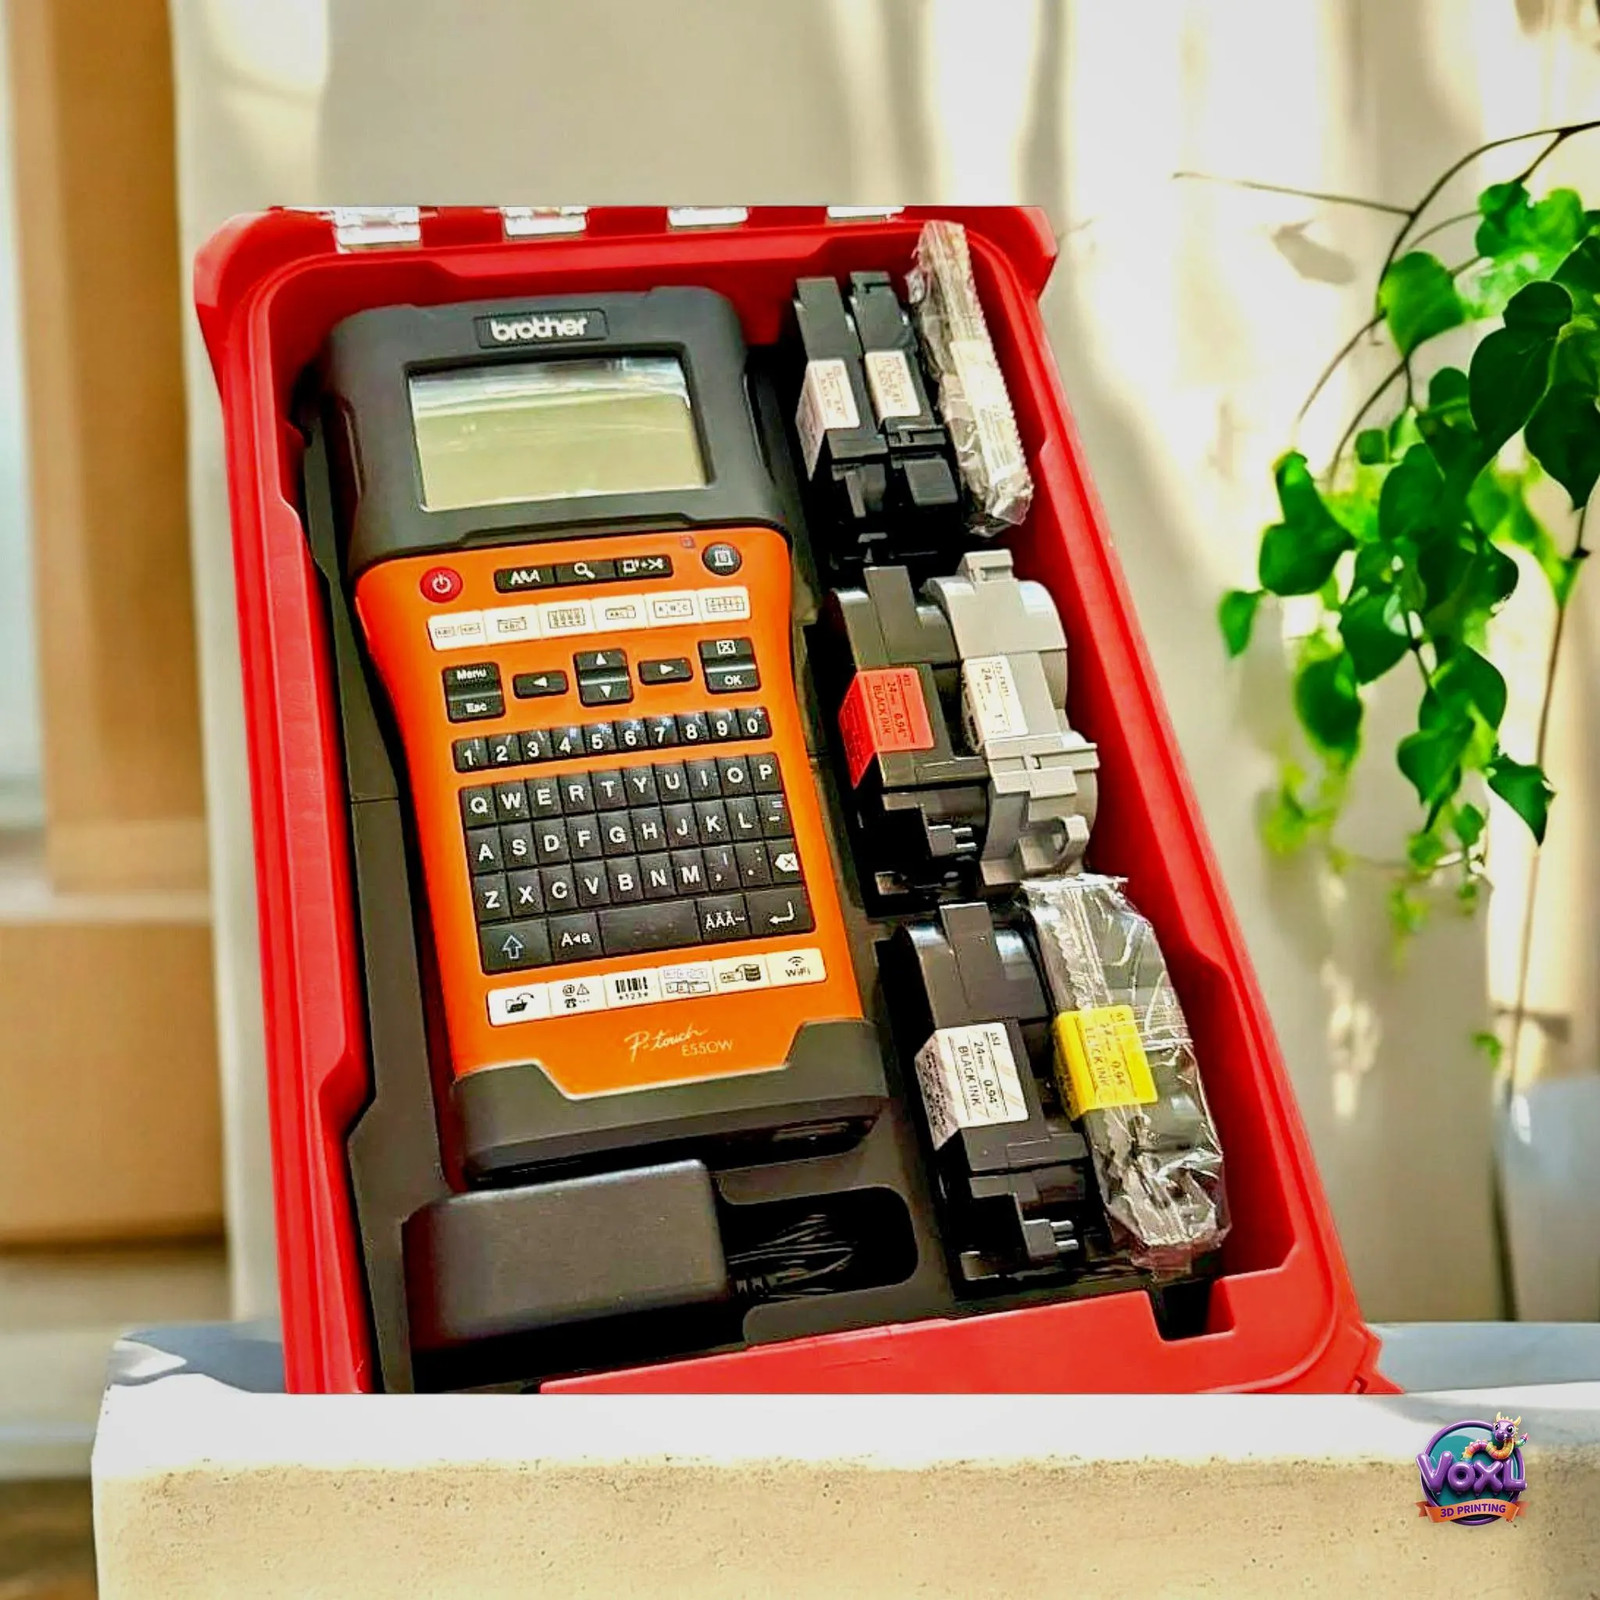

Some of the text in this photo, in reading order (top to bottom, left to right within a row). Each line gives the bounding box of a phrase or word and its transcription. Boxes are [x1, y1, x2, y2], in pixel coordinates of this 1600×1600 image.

[490, 316, 588, 341] brother
[456, 668, 487, 681] Menu
[724, 675, 742, 686] OK
[465, 702, 487, 713] Esc
[872, 684, 888, 716] BLACK
[464, 717, 758, 766] 1 2 3 4 5 6 7 8 9 0
[470, 764, 773, 814] Q W E R T Y U I O P
[478, 812, 753, 861] A S D F G H J K L
[485, 865, 701, 909] Z X C V B N M
[785, 967, 811, 978] WiFi
[682, 1040, 733, 1057] E550W
[957, 1045, 981, 1106] BLACK INK
